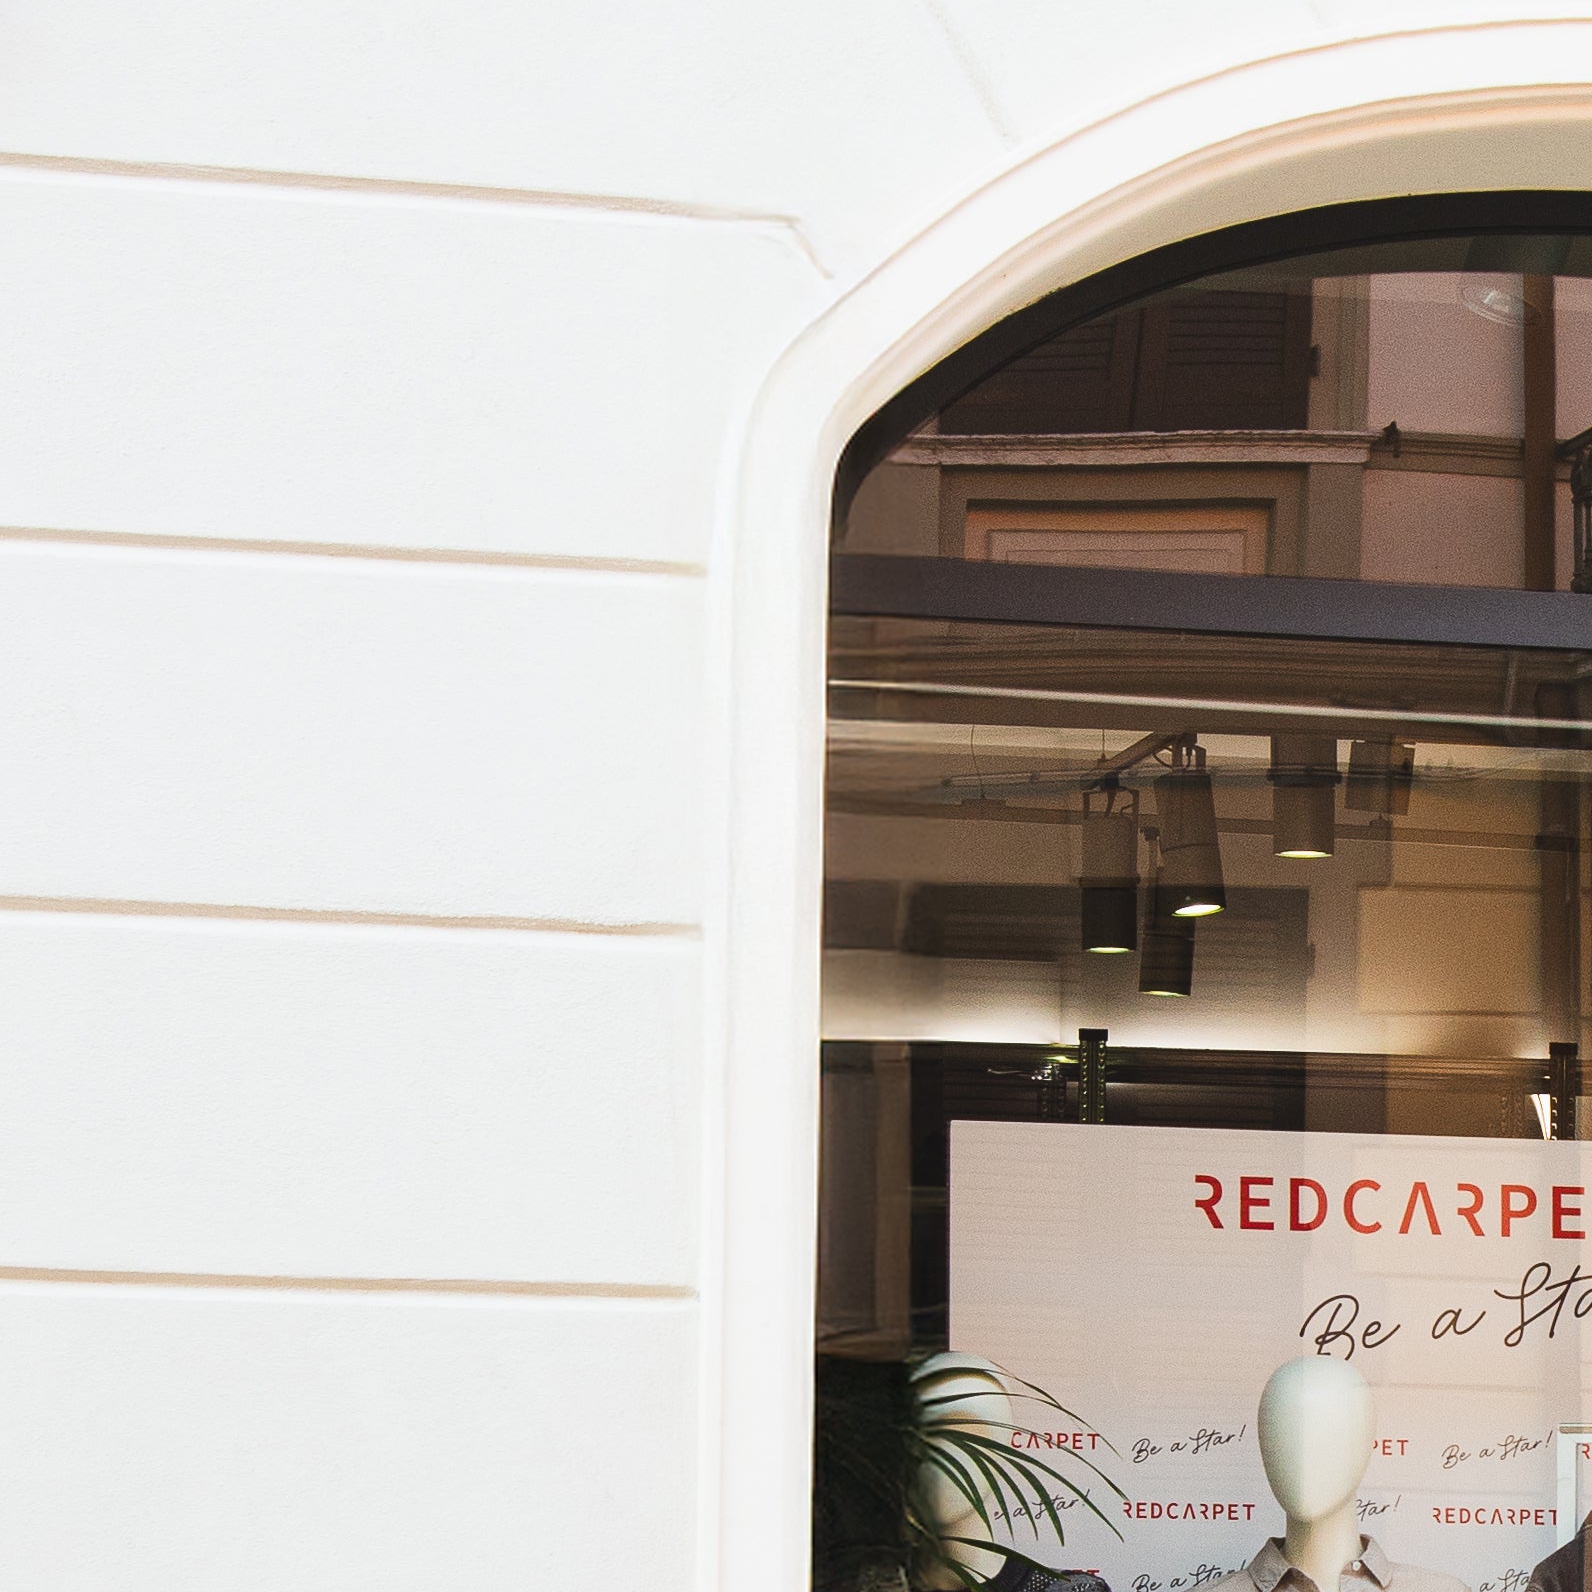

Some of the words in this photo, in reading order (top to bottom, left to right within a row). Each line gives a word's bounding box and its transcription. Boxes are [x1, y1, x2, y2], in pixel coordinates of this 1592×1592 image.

[1299, 1293, 1401, 1360] Be
[1431, 1304, 1486, 1340] a
[1010, 1431, 1101, 1451] CARPET
[1131, 1438, 1162, 1464] Be
[1170, 1441, 1188, 1452] a
[1188, 1424, 1246, 1455] Star!
[1441, 1444, 1471, 1469] Be
[1479, 1446, 1497, 1458] a
[1497, 1430, 1553, 1460] Star!
[1122, 1501, 1255, 1521] REDCARPET
[1432, 1507, 1557, 1526] REDCARPET
[1169, 1577, 1188, 1589] a
[1479, 1582, 1496, 1592] a
